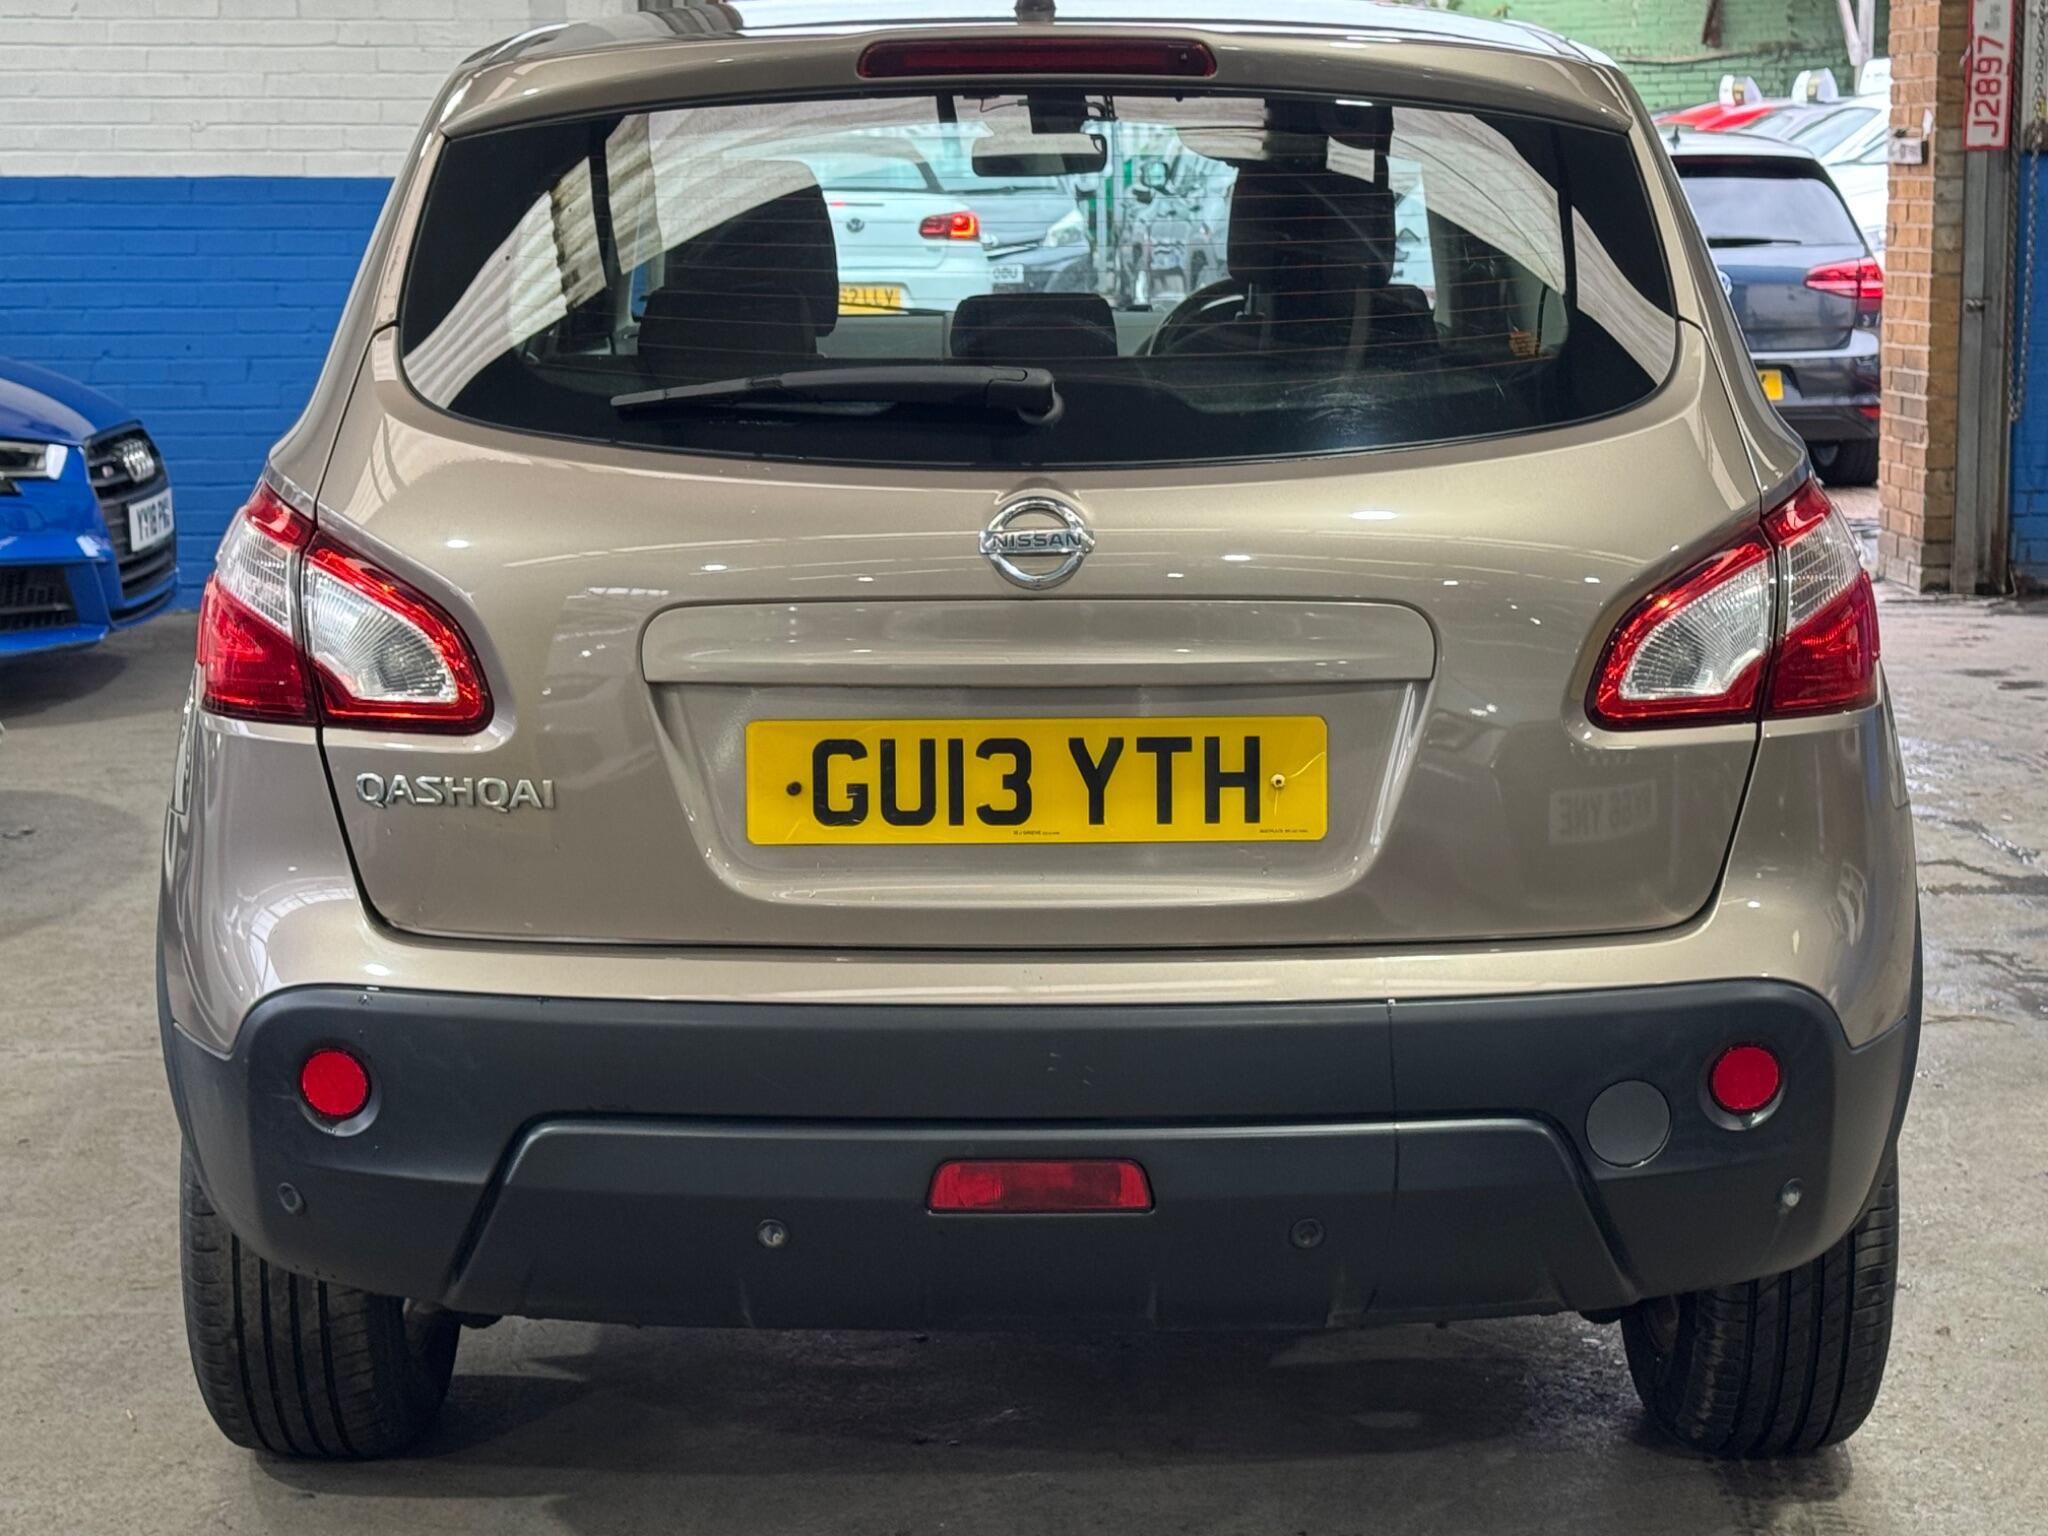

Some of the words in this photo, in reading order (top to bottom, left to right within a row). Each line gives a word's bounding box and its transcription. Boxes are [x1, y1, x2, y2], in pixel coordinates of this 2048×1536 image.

[1973, 35, 2005, 138] J2897
[992, 533, 1082, 548] NISSAN
[356, 773, 555, 812] QASHQAI
[812, 737, 1033, 827] GU13
[1067, 735, 1261, 825] YTH
